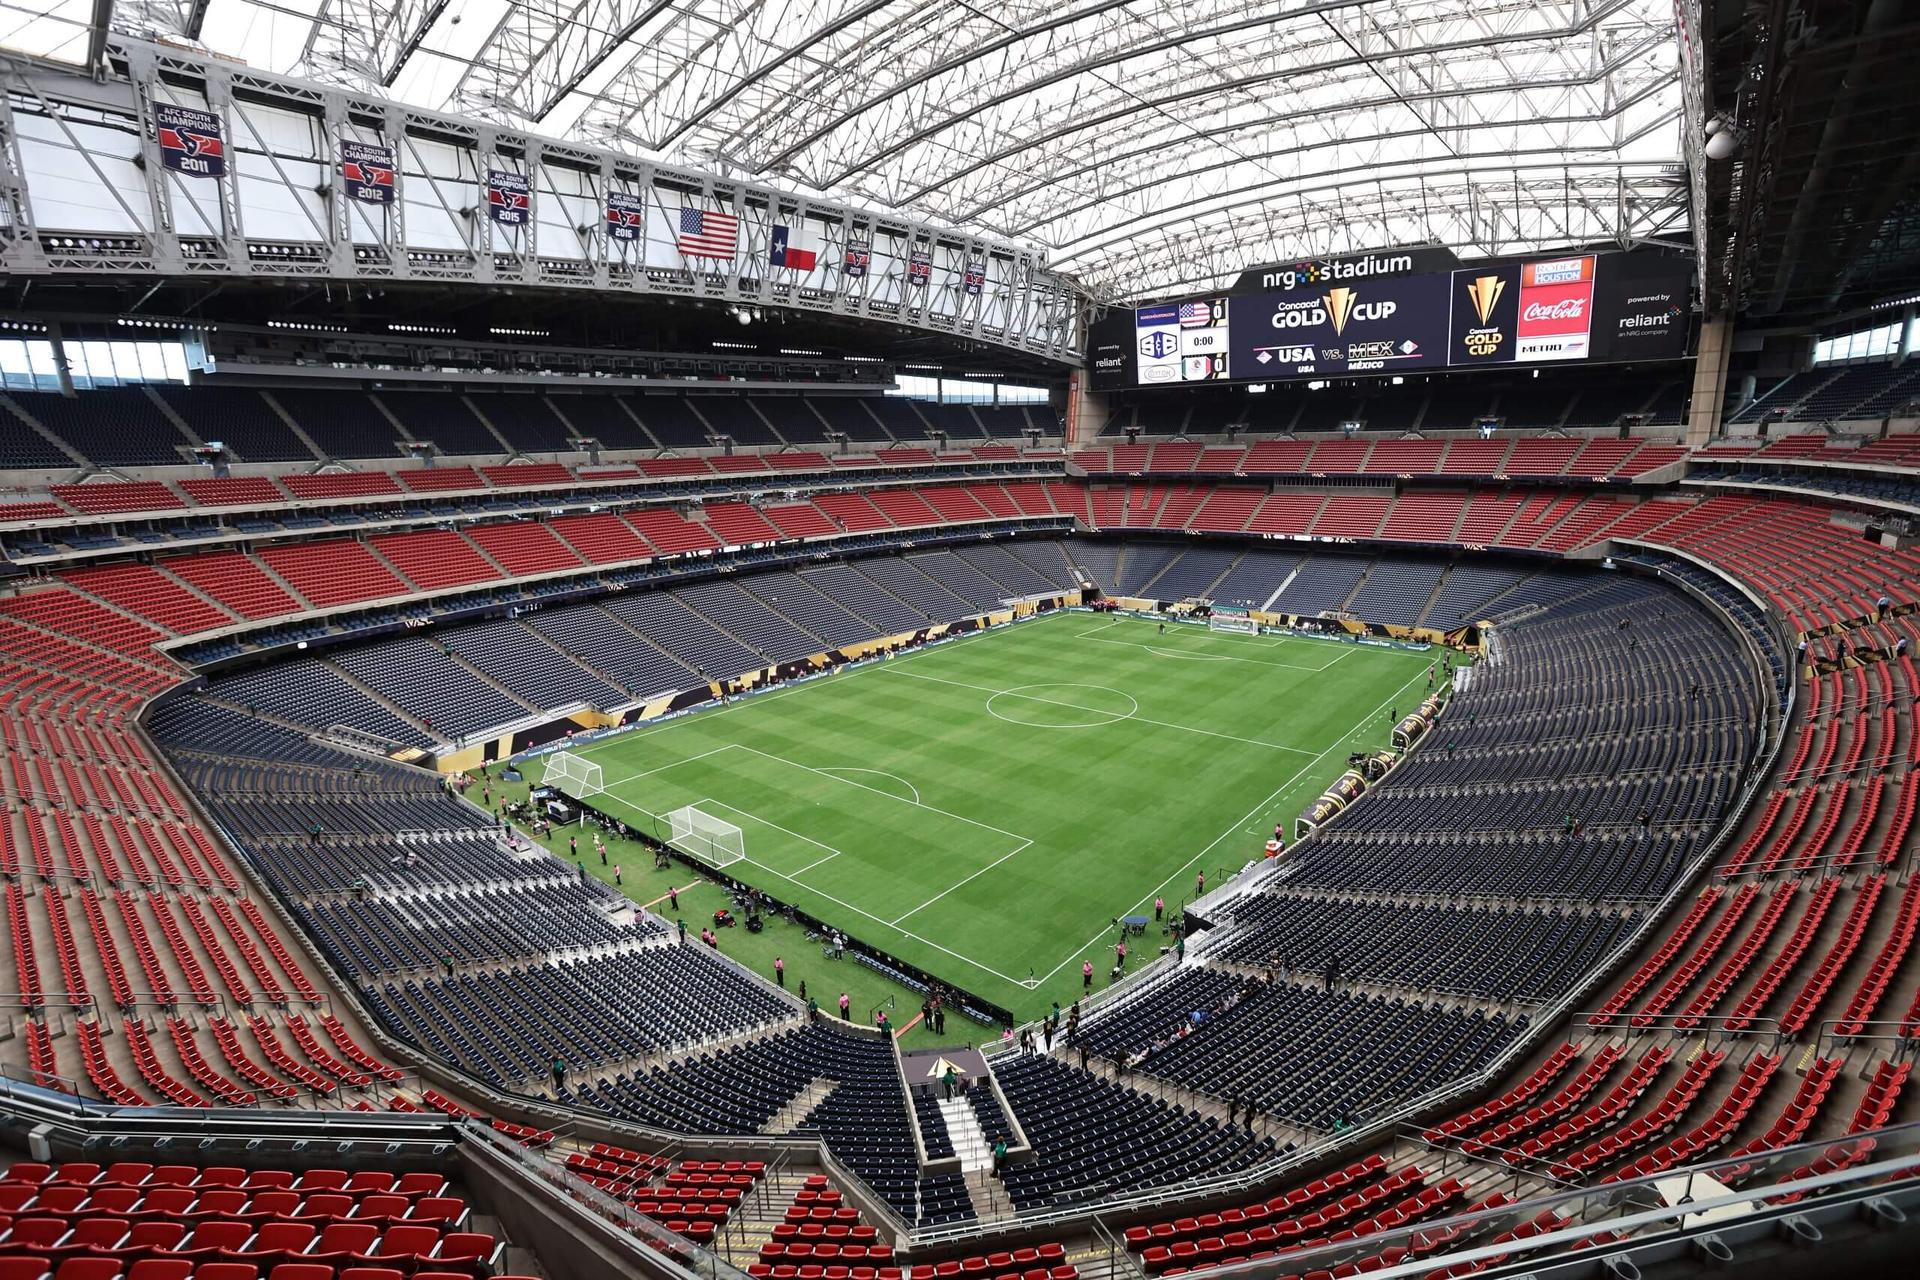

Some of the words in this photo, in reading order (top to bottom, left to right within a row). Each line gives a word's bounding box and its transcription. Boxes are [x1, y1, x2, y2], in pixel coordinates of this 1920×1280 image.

[164, 107, 180, 116] AFC
[182, 111, 211, 122] SOUTH
[158, 113, 218, 132] CHAMPIONS
[349, 144, 362, 152] AFC
[363, 147, 386, 156] SOUTH
[344, 150, 391, 165] CHAMPIONS
[180, 157, 209, 173] 2011
[490, 178, 528, 190] CHAMPIONS
[358, 187, 383, 200] 2012
[499, 210, 520, 222] 2015
[615, 228, 633, 238] 2016
[1263, 270, 1296, 290] nrg
[1320, 255, 1412, 281] stadium
[1536, 271, 1580, 283] HOUSTON
[1278, 298, 1321, 311] Concacaf
[1627, 294, 1660, 304] powered
[1213, 305, 1222, 319] 0
[1271, 308, 1327, 328] GOLD
[1353, 301, 1397, 321] CUP
[1523, 297, 1587, 322] Coca-Cola
[1619, 313, 1670, 328] reliant
[1193, 336, 1213, 346] 0:00
[1464, 333, 1503, 346] GOLD
[1278, 347, 1316, 363] USA
[1348, 341, 1395, 359] MEX
[1469, 344, 1497, 355] CUP
[1522, 344, 1562, 353] METRO
[1096, 357, 1122, 367] reliant
[1214, 359, 1223, 372] 0
[1348, 360, 1384, 370] MÉXICO
[1298, 365, 1315, 373] USA
[607, 728, 620, 736] GOLD
[543, 745, 558, 754] GOLD
[562, 741, 573, 749] CUP
